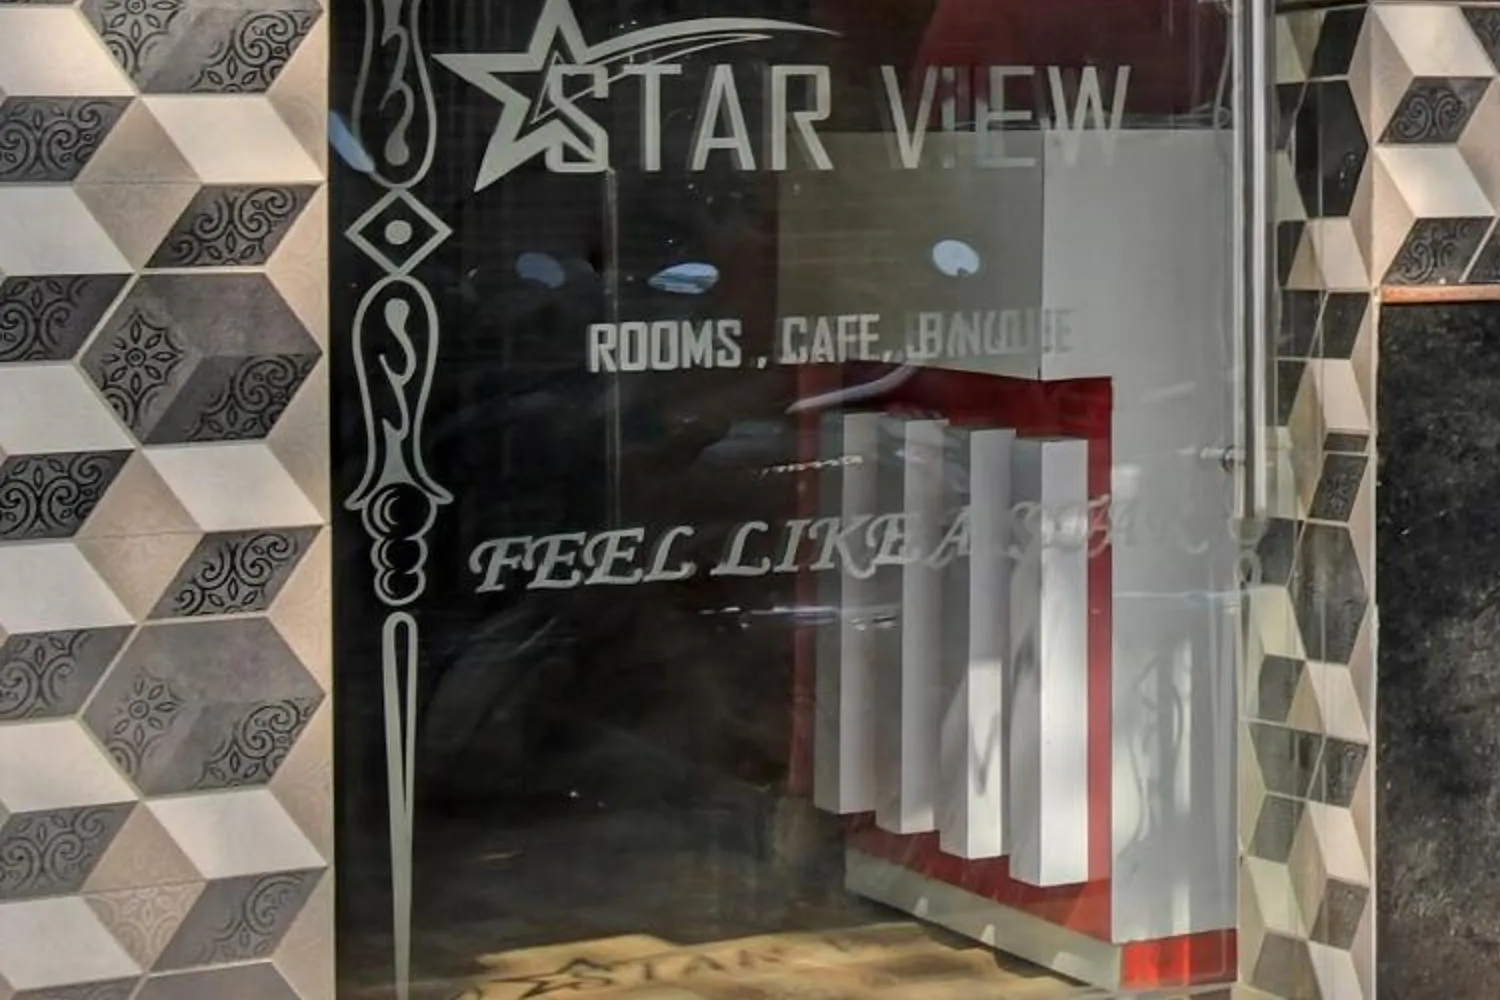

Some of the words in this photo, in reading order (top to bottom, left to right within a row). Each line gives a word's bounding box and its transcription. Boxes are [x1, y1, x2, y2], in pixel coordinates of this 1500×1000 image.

[545, 62, 834, 173] STAR
[469, 524, 695, 593] FEEL
[709, 512, 921, 580] LIKE
